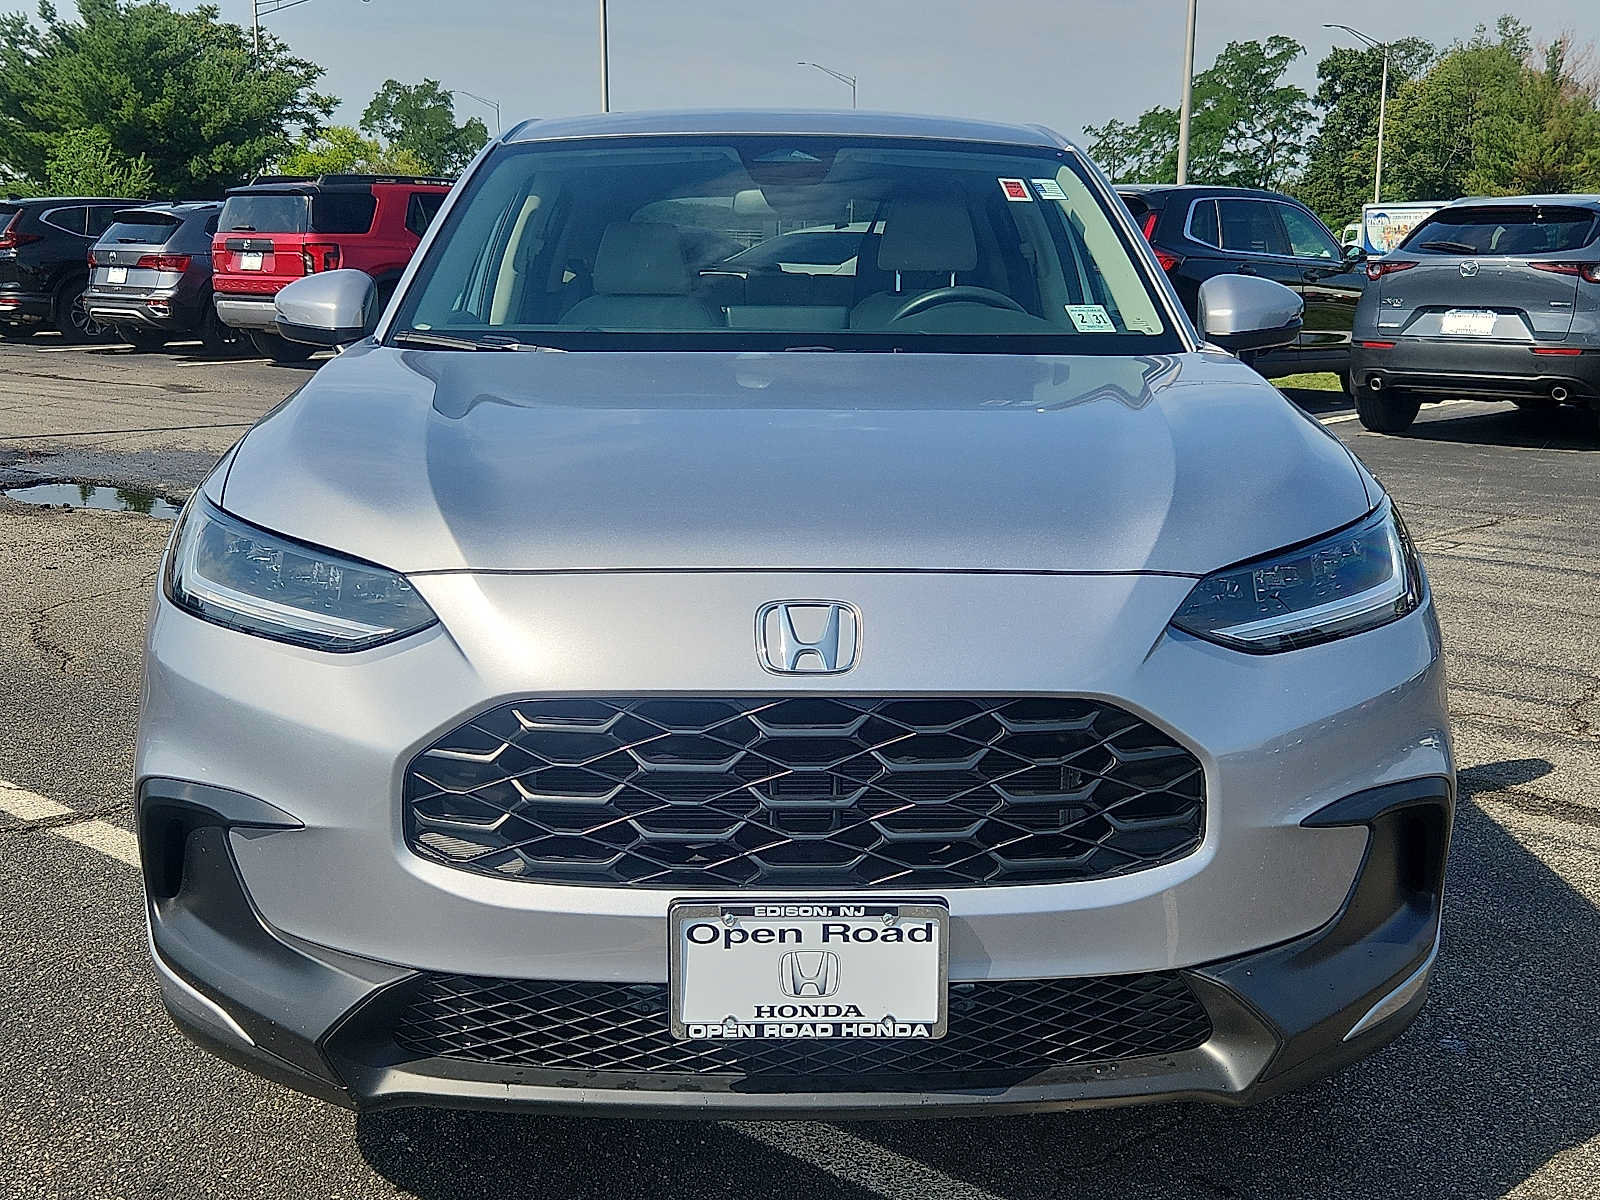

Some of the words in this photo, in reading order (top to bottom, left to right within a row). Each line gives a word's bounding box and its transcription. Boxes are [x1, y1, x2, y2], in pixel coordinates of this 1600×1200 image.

[1077, 313, 1088, 324] 2
[1092, 313, 1108, 325] 31
[754, 906, 833, 918] EDISON,
[839, 906, 866, 917] NJ
[686, 923, 803, 949] Open
[822, 922, 933, 943] Road
[753, 1004, 865, 1018] HONDA
[688, 1023, 756, 1038] OPEN
[763, 1023, 834, 1038] ROAD
[841, 1023, 930, 1038] HONDA
